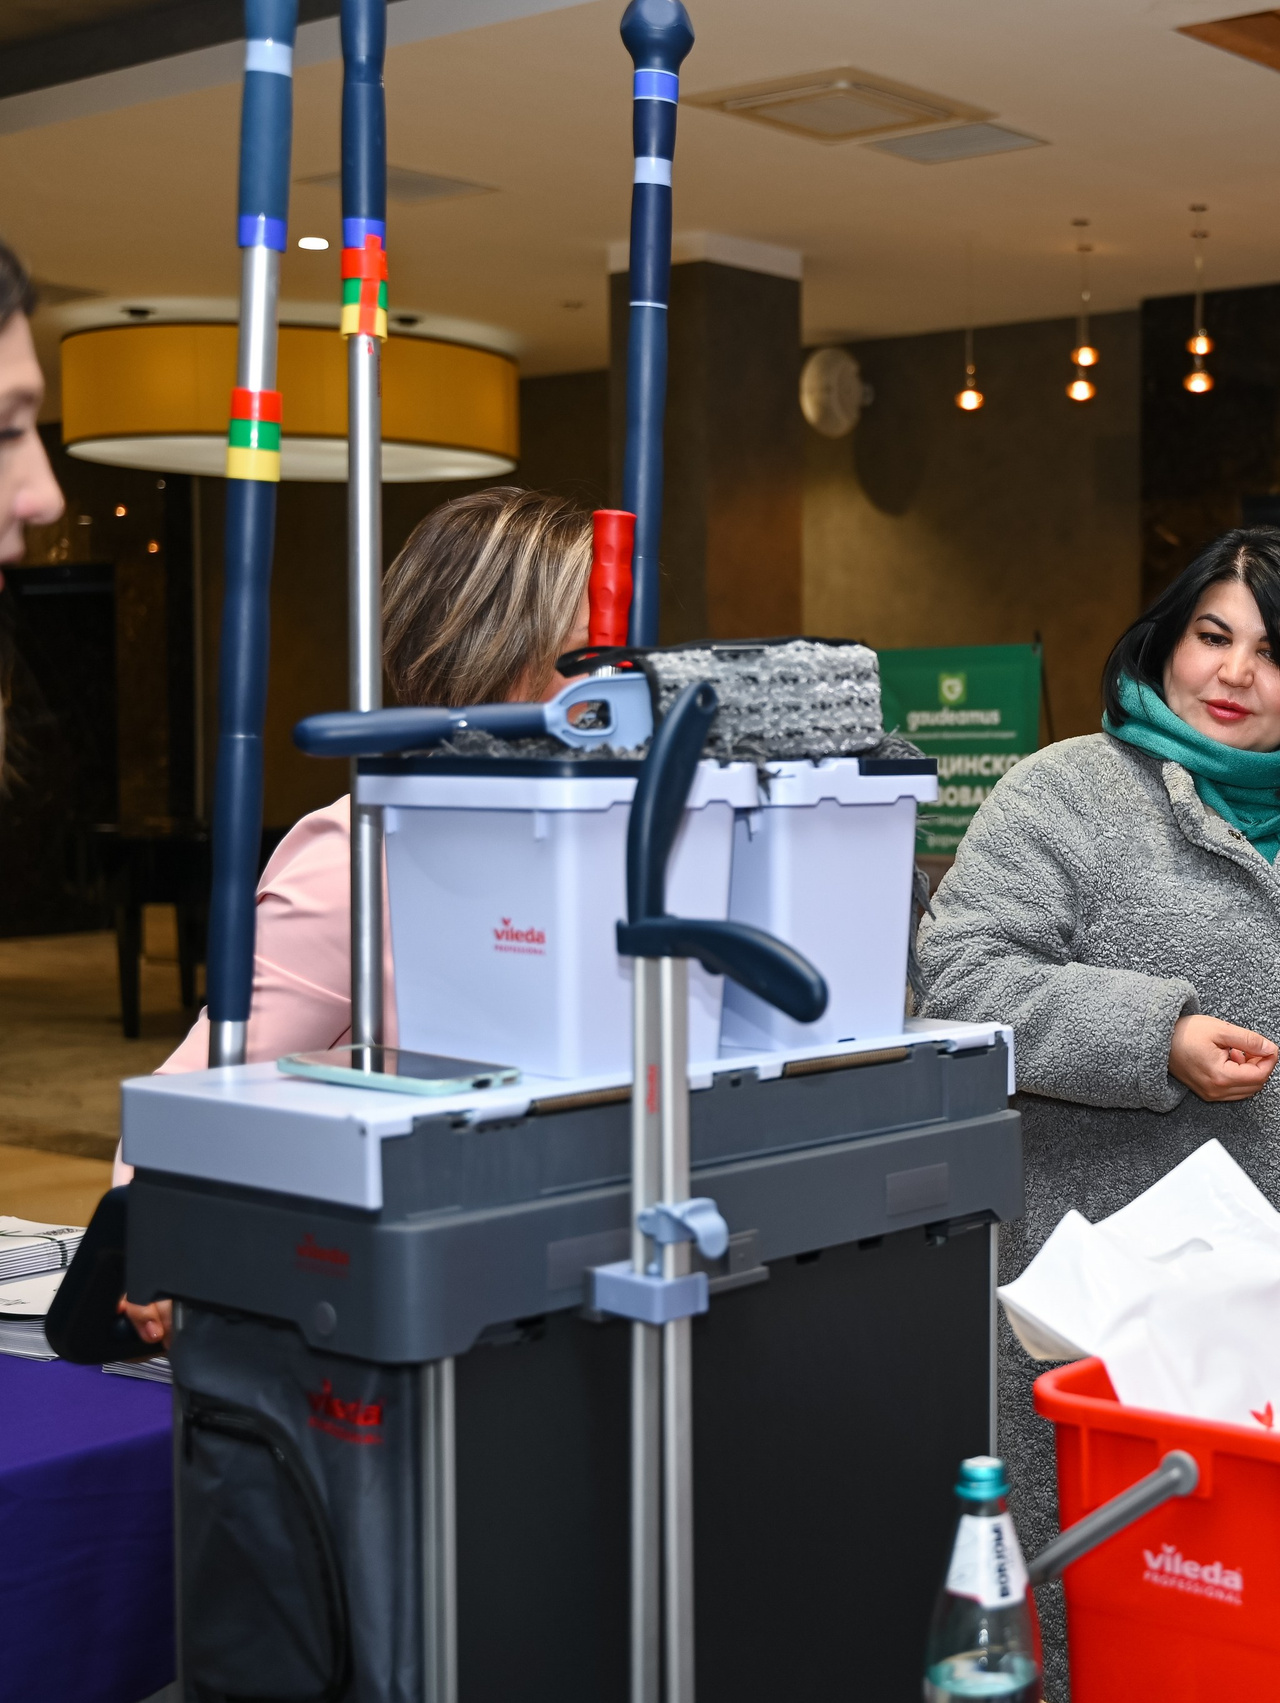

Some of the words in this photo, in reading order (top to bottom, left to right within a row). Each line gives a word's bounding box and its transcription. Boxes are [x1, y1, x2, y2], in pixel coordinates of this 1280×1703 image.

[906, 706, 1001, 732] gaudeamus
[938, 753, 1030, 780] ЦИНСКО
[493, 917, 546, 945] vileda
[1142, 1542, 1244, 1592] vileda
